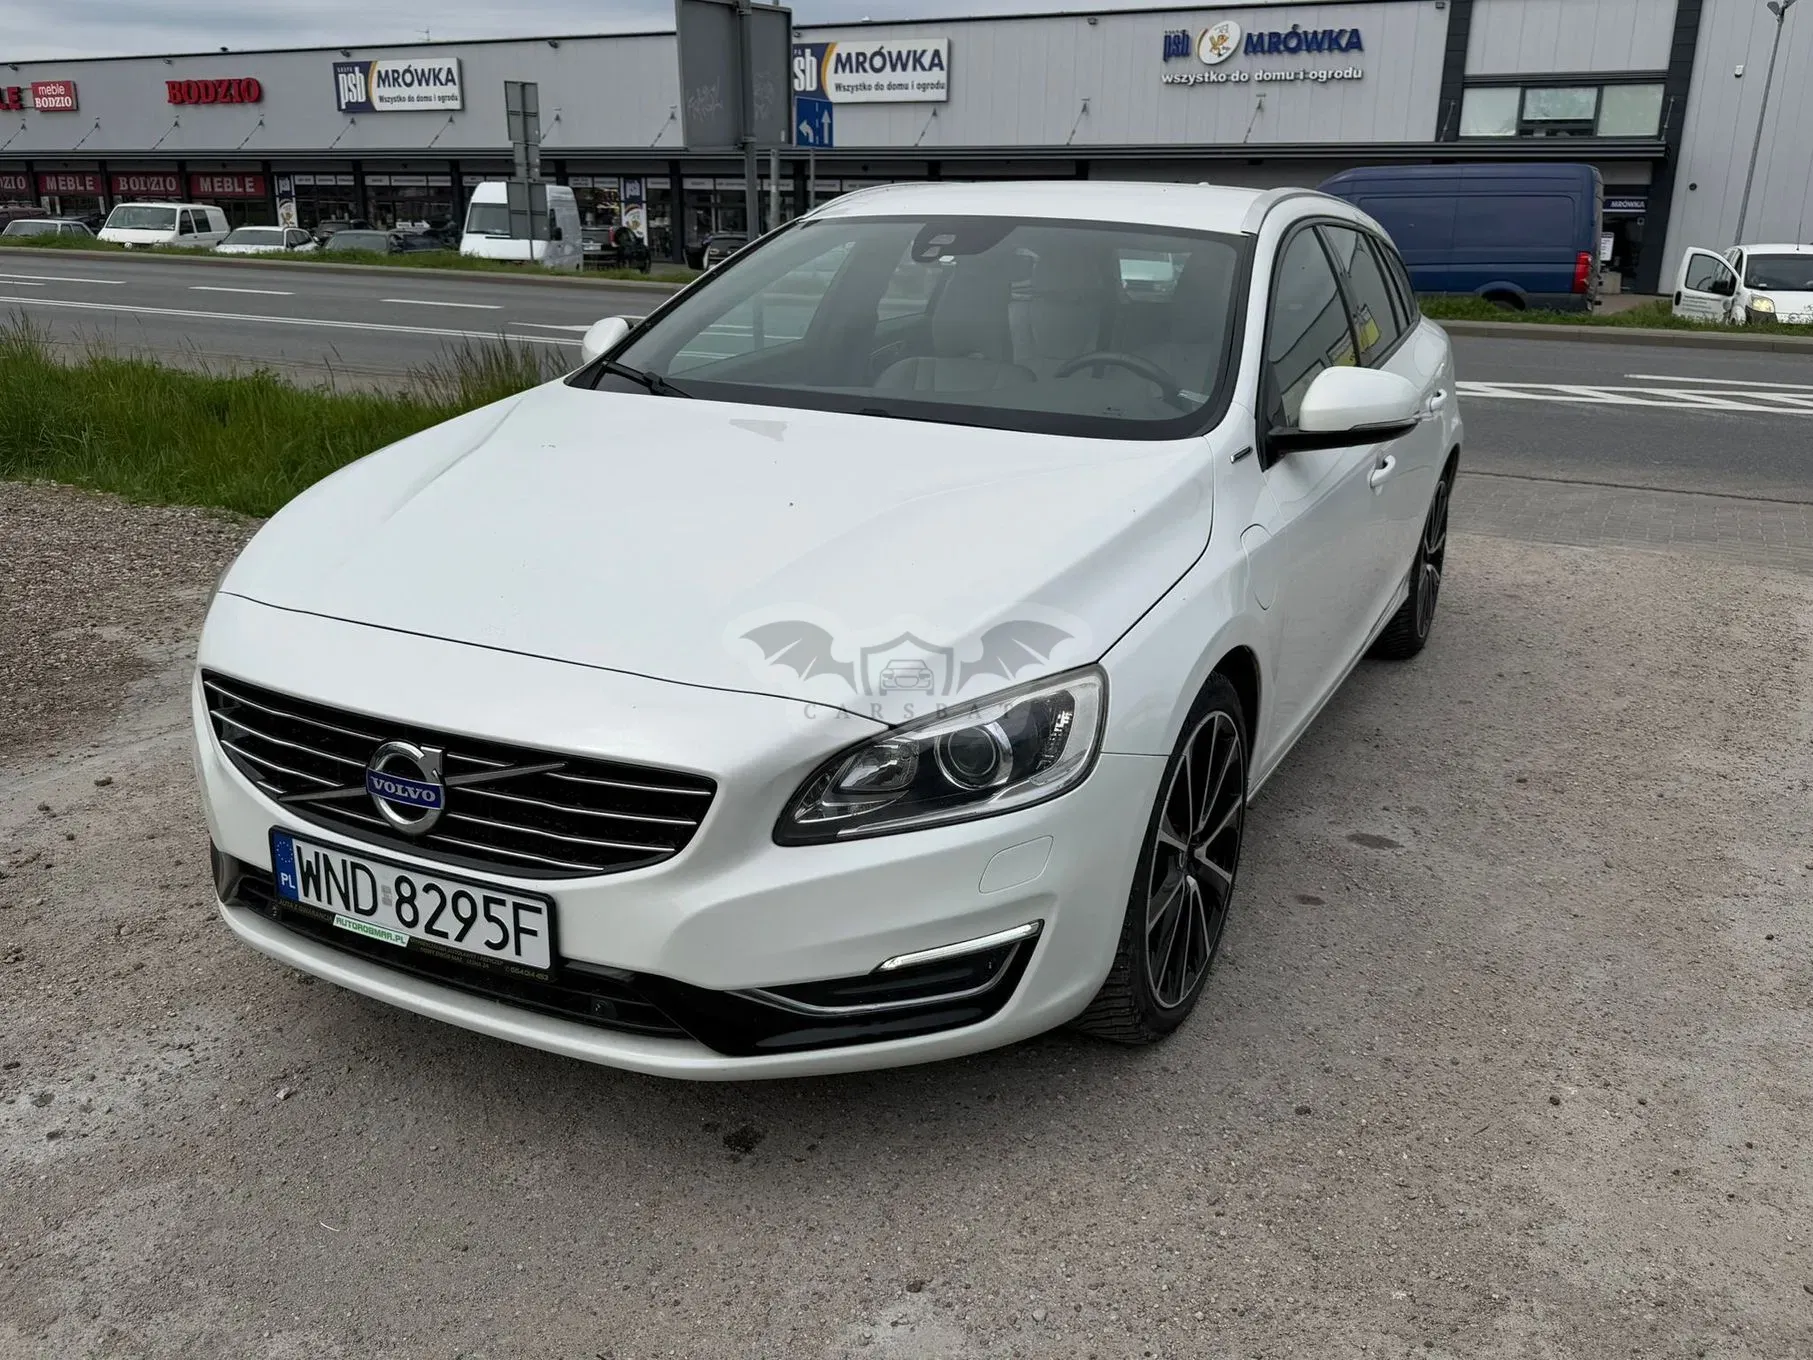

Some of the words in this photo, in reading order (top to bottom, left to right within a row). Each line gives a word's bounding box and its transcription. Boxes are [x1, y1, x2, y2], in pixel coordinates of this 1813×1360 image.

[1244, 24, 1364, 55] MRÓWKA
[793, 48, 818, 92] sb
[833, 45, 945, 75] MRÓWKA
[377, 64, 457, 88] MRÓWKA
[835, 82, 872, 94] Wszystko
[874, 81, 884, 91] do
[887, 81, 909, 91] domu
[916, 79, 945, 93] ogrodu
[1161, 70, 1227, 86] wszystko
[1231, 70, 1249, 82] do
[1254, 69, 1295, 82] domu
[1309, 66, 1363, 83] ogrodu
[38, 83, 66, 95] meble
[165, 77, 262, 105] BODZIO
[338, 66, 366, 110] psb
[35, 96, 72, 108] BODZIO
[46, 176, 95, 191] MEBLE
[119, 175, 177, 192] BODZIO
[200, 176, 255, 192] MEBLE
[372, 776, 436, 803] VOLVO
[281, 872, 296, 890] PL
[296, 846, 379, 916] WND
[394, 875, 545, 956] 8295F
